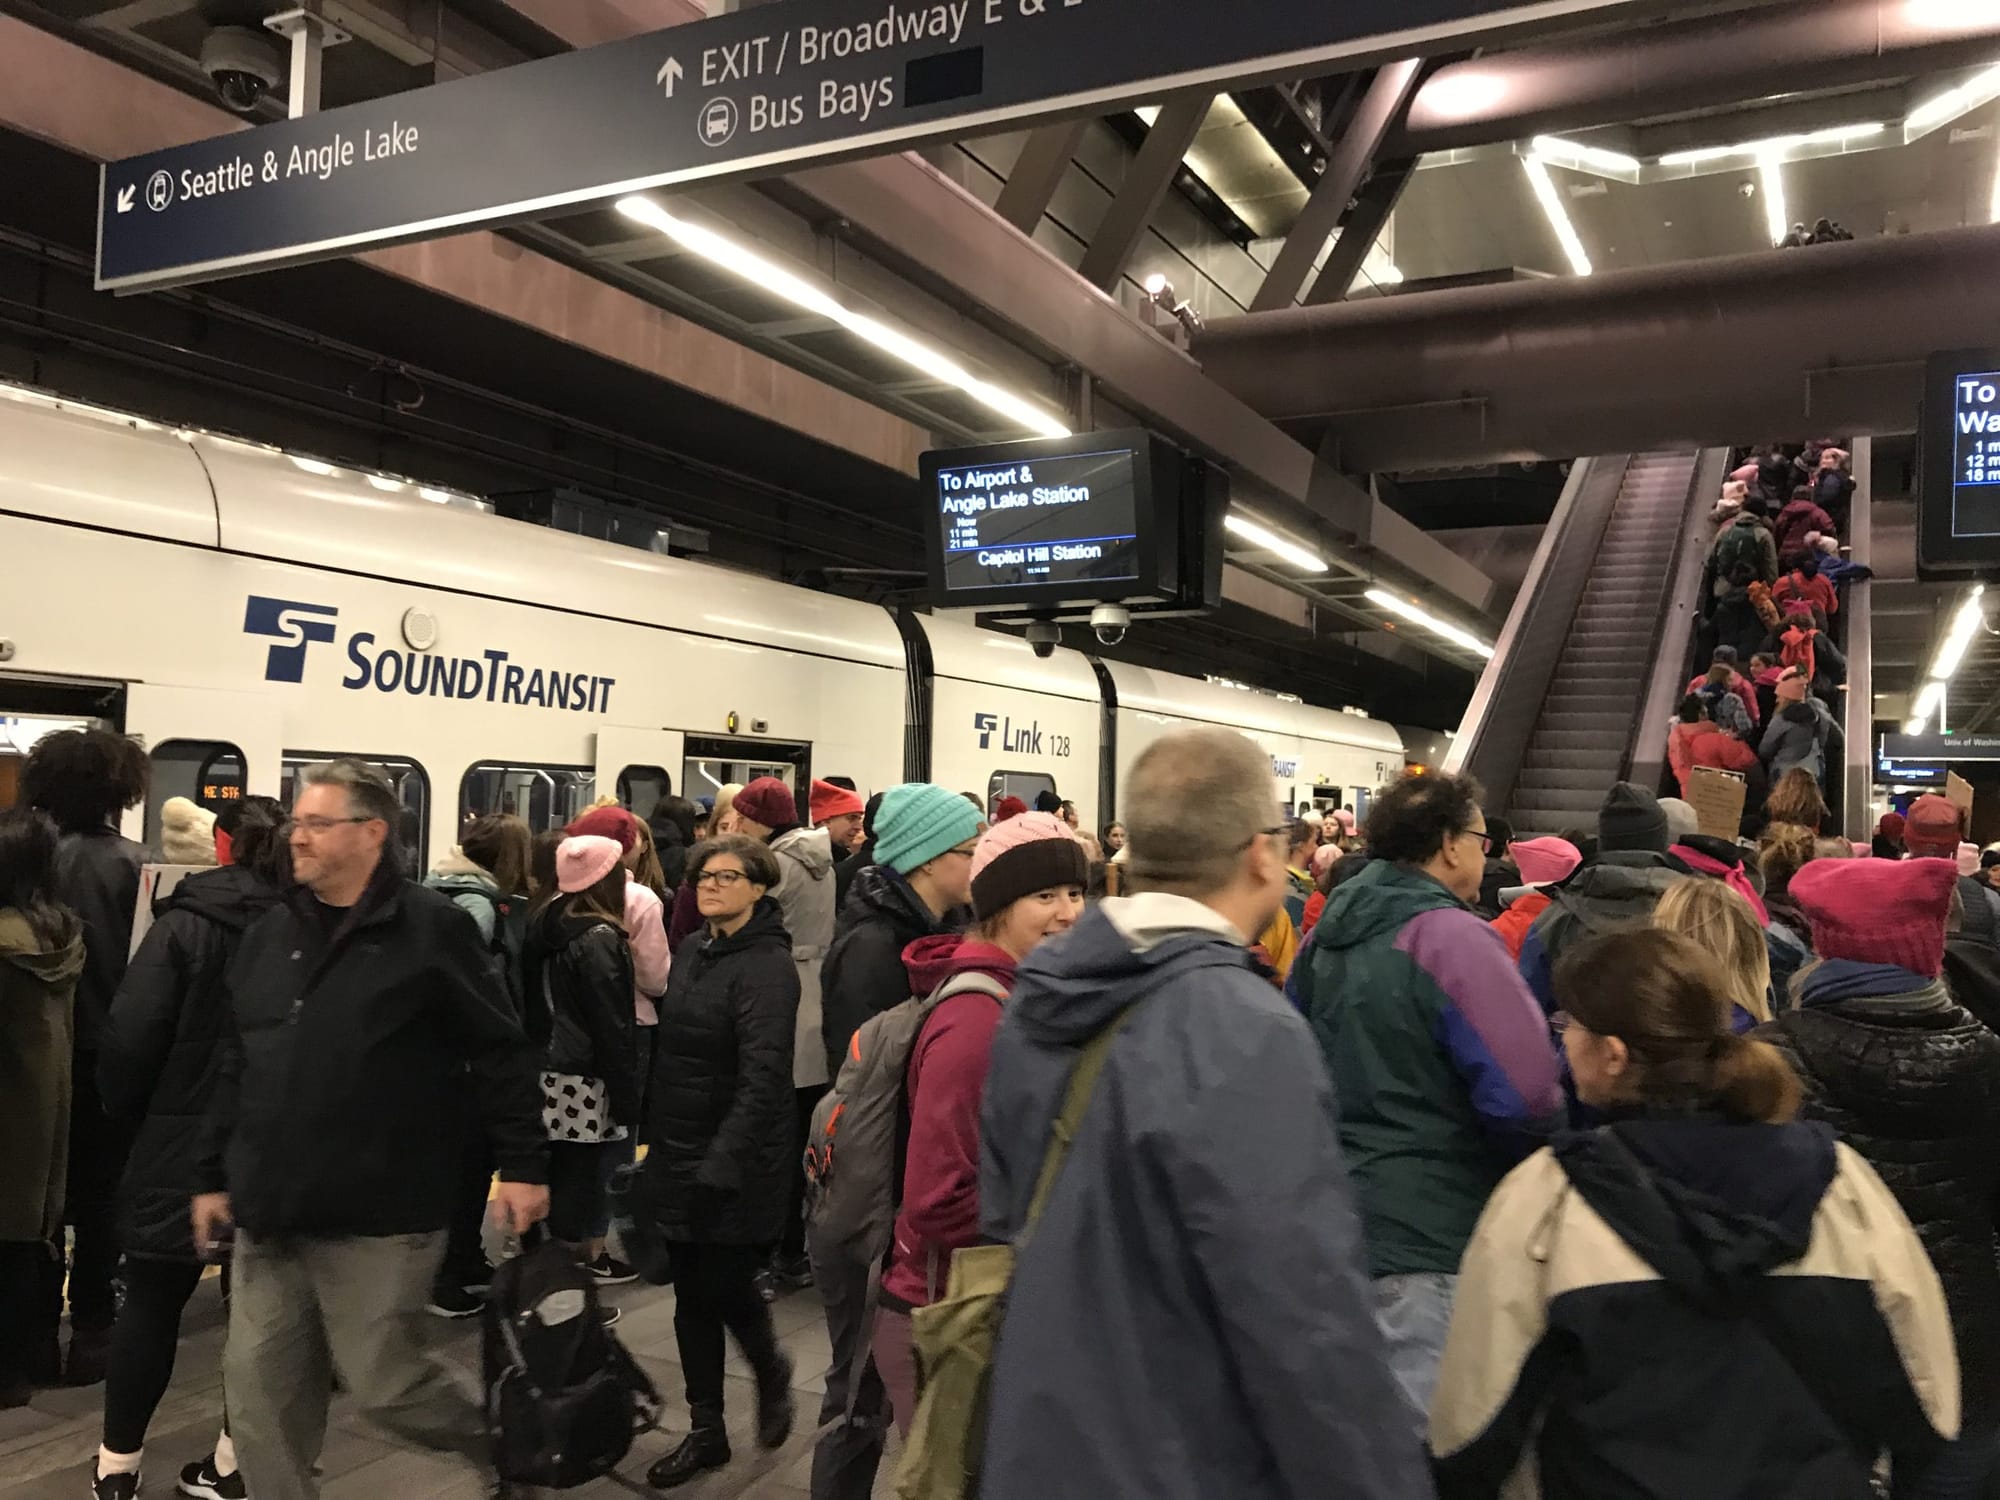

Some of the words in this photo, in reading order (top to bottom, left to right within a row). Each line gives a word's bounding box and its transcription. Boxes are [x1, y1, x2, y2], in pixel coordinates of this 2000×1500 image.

[702, 36, 770, 87] EXIT
[776, 32, 789, 74] /
[800, 0, 968, 64] Broadway
[750, 96, 804, 133] Bus
[820, 77, 893, 121] Bays
[181, 156, 254, 201] Seattle
[261, 151, 278, 182] &
[286, 133, 354, 179] Angle
[365, 121, 419, 160] Lake
[1959, 381, 1996, 404] To
[1976, 440, 1983, 454] 1
[1967, 454, 1985, 467] 12
[940, 473, 961, 490] To
[964, 468, 1017, 490] Airport
[1019, 466, 1034, 483] &
[1966, 469, 1985, 482] 18
[942, 495, 986, 516] Angle
[990, 491, 1028, 509] Lake
[1032, 486, 1090, 505] Station
[949, 529, 960, 539] 11
[950, 539, 961, 549] 21
[978, 549, 1025, 567] Capitol
[1027, 547, 1050, 562] Hill
[1052, 544, 1102, 561] Station
[1003, 716, 1042, 755] Link
[1050, 735, 1070, 757] 128
